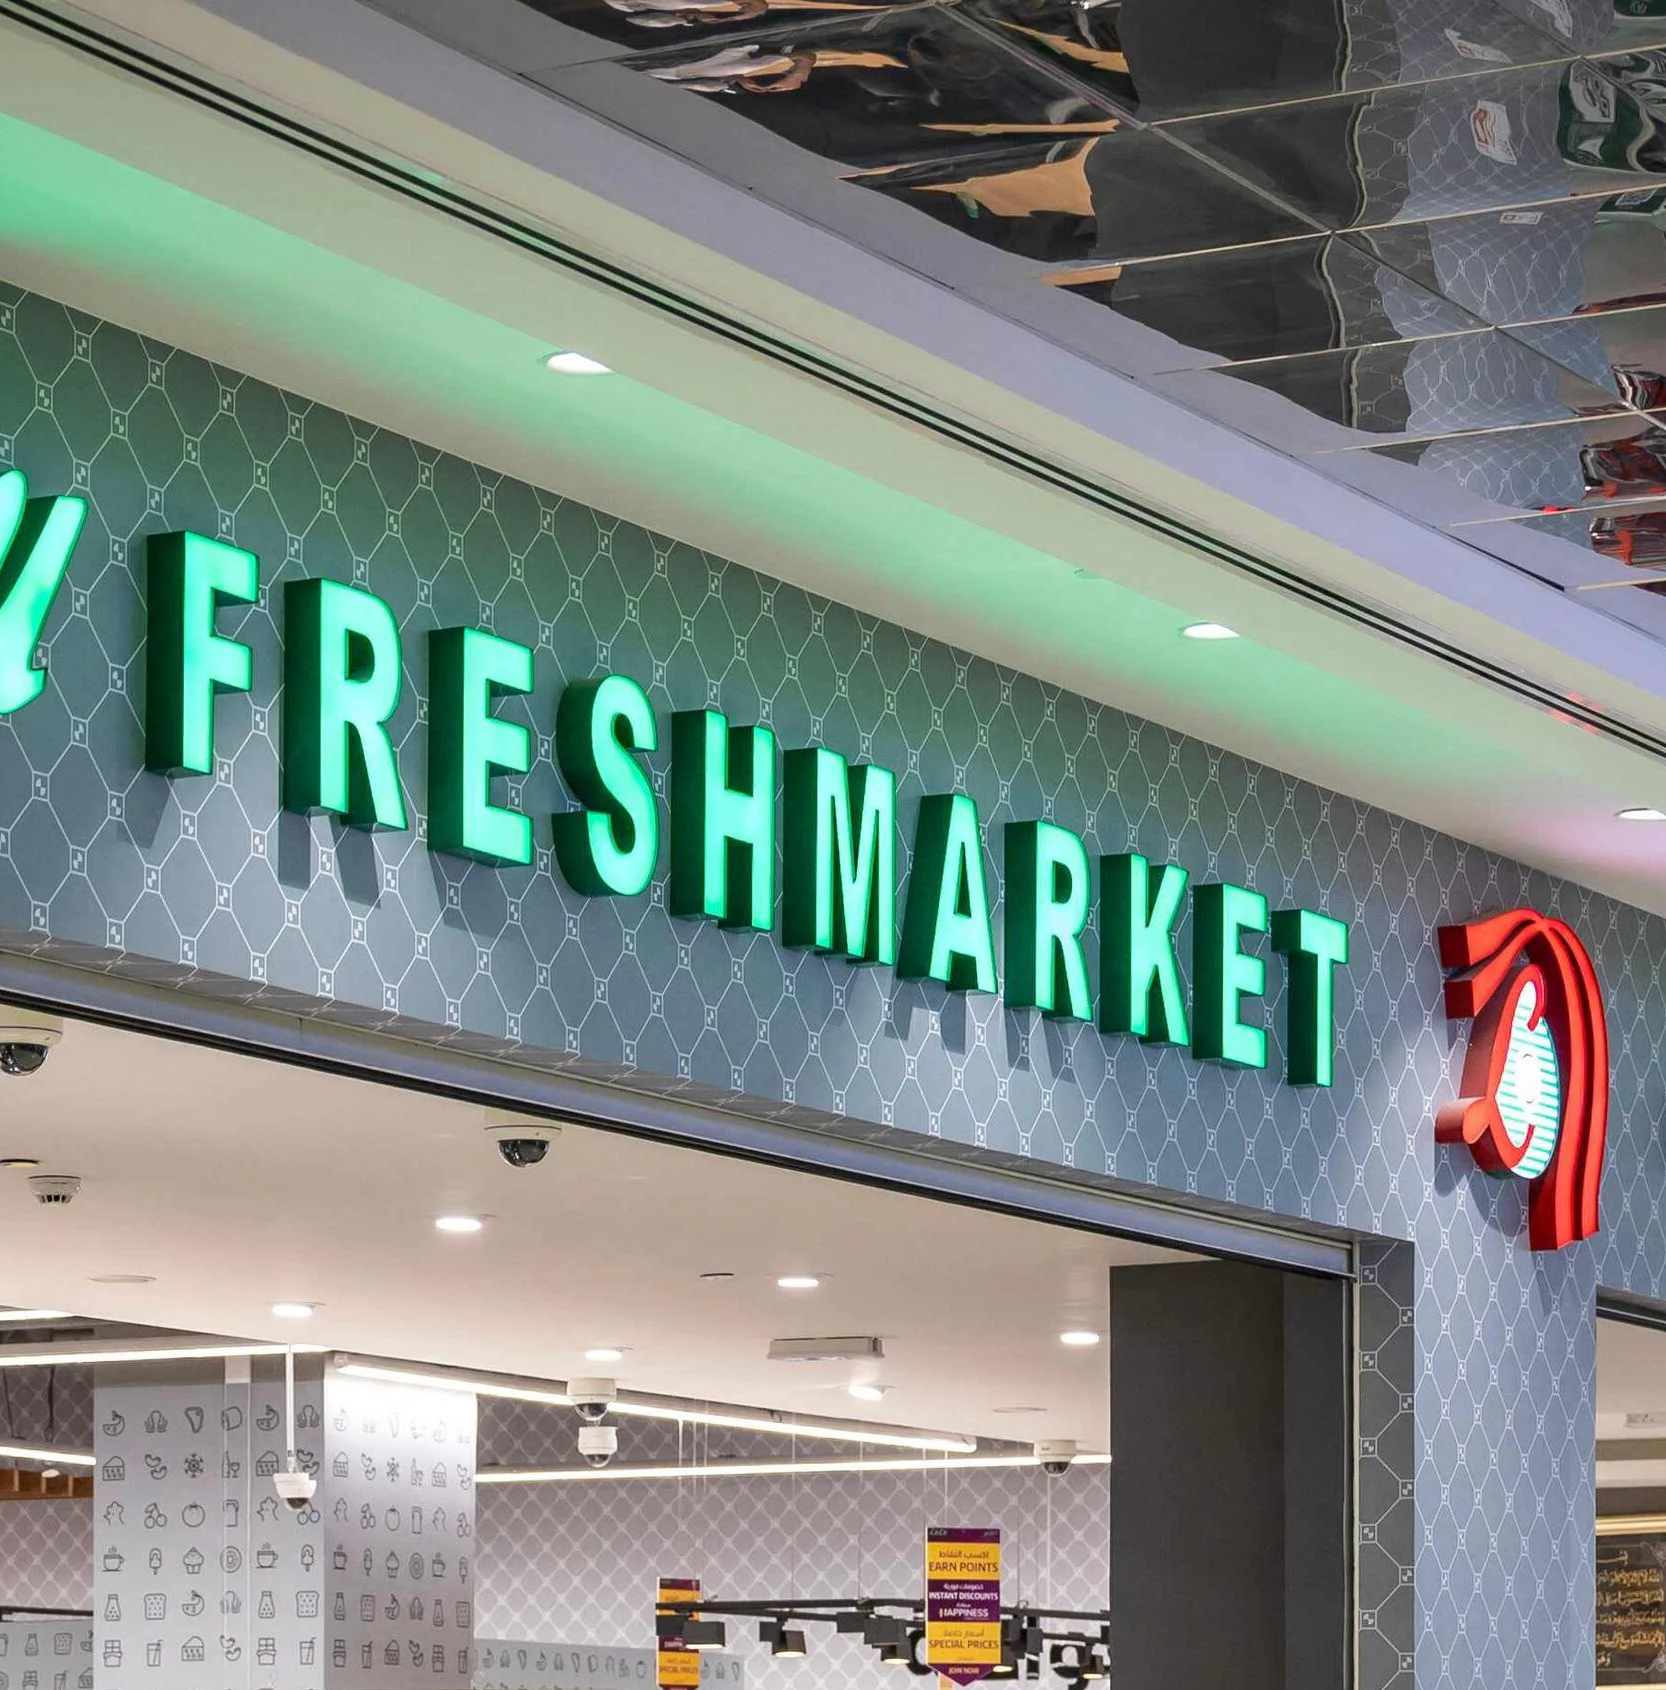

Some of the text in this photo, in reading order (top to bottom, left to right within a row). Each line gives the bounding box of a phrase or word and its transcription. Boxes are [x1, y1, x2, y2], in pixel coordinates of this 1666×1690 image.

[146, 530, 1349, 1089] FRESHMARKET
[929, 1561, 999, 1573] EARN POINTS
[929, 1591, 999, 1601] INSTANT DISCOUNTS
[939, 1608, 989, 1618] HAPPINESS
[929, 1638, 999, 1650] SPECIAL PRICES
